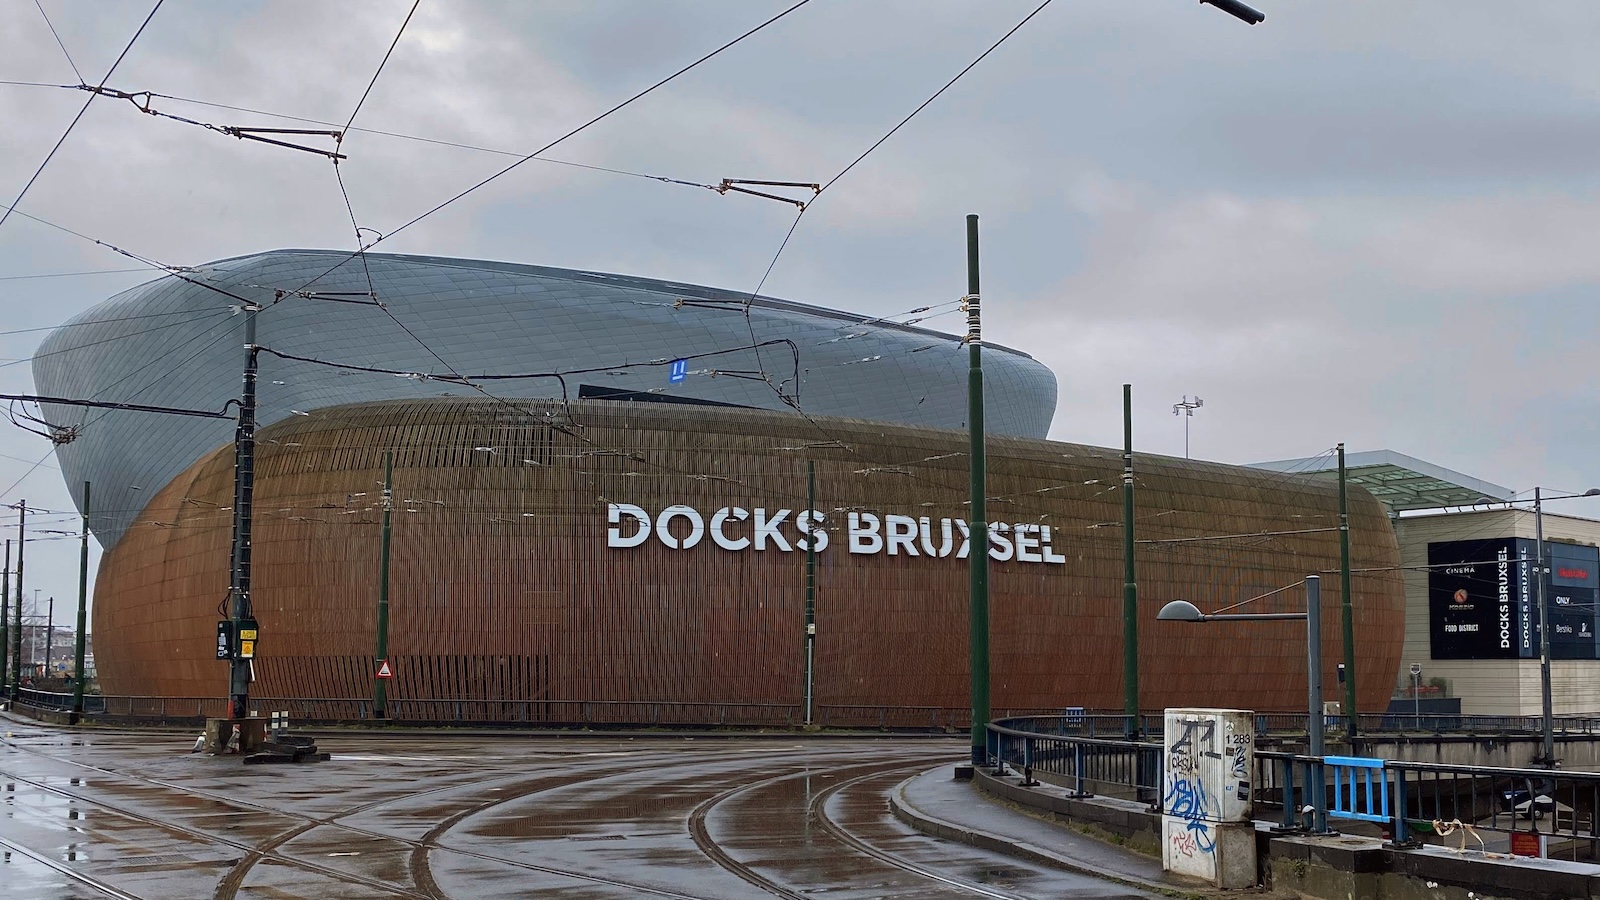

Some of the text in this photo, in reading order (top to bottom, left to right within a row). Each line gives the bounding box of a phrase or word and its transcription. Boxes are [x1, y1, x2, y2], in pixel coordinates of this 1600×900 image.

[608, 503, 829, 553] DOCKS
[1498, 546, 1510, 649] DOCKS BRUXSEL
[1556, 596, 1570, 604] ONLY
[1444, 624, 1458, 632] FOOD
[1522, 604, 1530, 648] DOCKS
[1556, 624, 1572, 633] Bershka
[1233, 733, 1251, 744] 283
